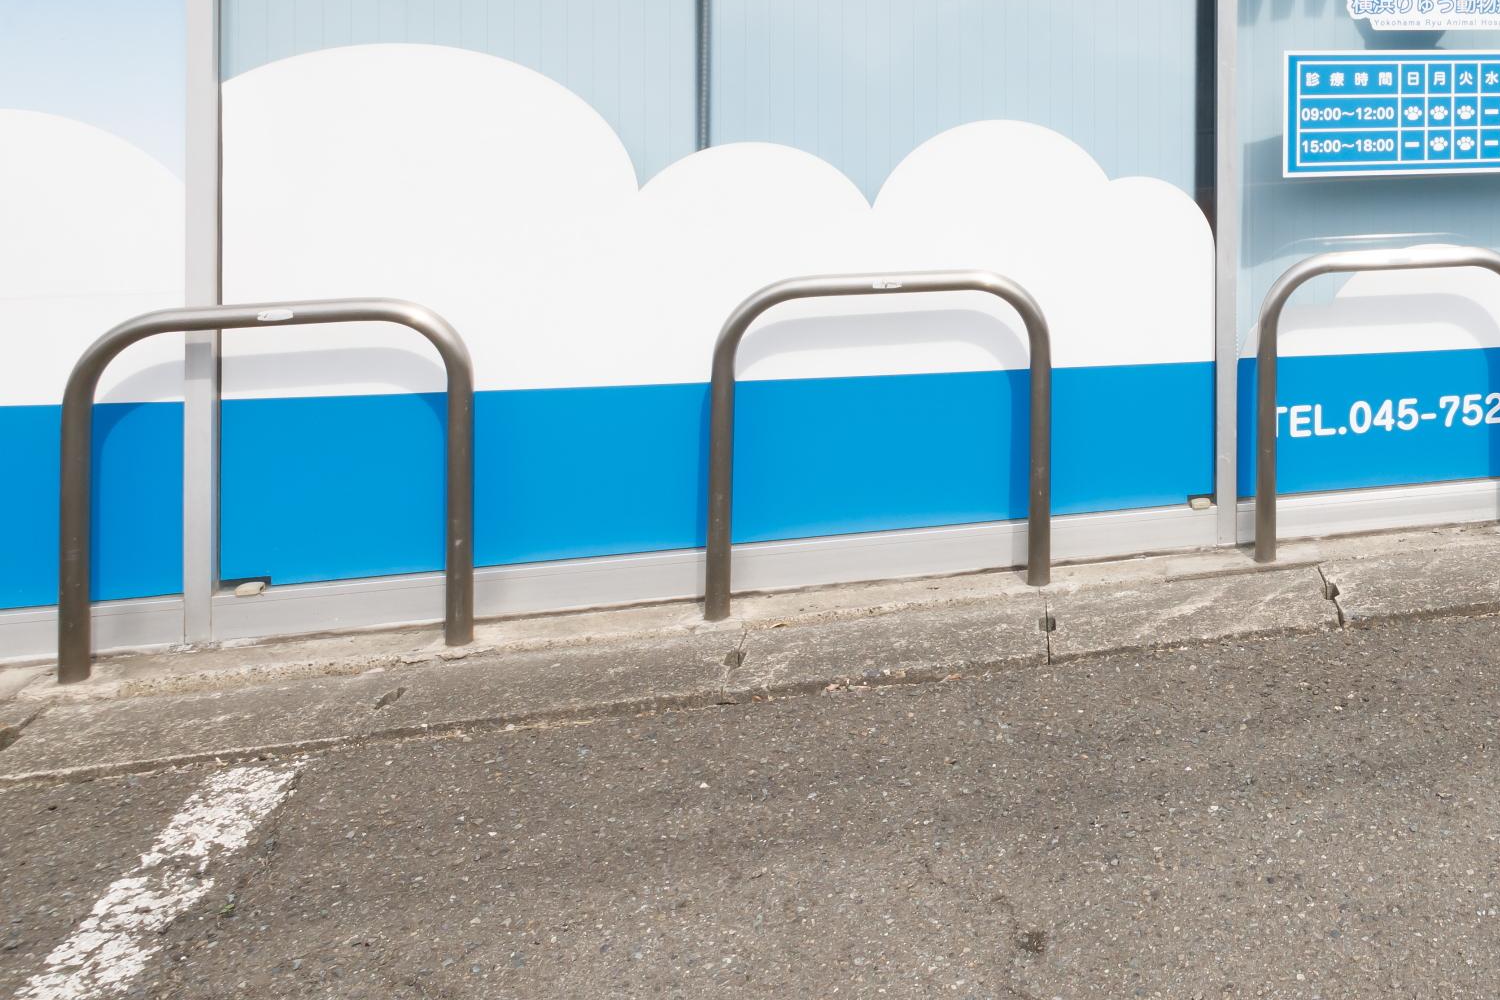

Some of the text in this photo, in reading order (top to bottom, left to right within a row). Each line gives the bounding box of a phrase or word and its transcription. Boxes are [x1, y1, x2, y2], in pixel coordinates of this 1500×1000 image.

[1374, 19, 1421, 27] Yokohama
[1426, 19, 1442, 28] Ryu
[1447, 18, 1477, 26] Animal
[1305, 71, 1393, 87] 診療時間
[1407, 71, 1420, 86] 日
[1433, 71, 1446, 86] 月
[1459, 71, 1473, 86] 火
[1485, 71, 1499, 85] 水
